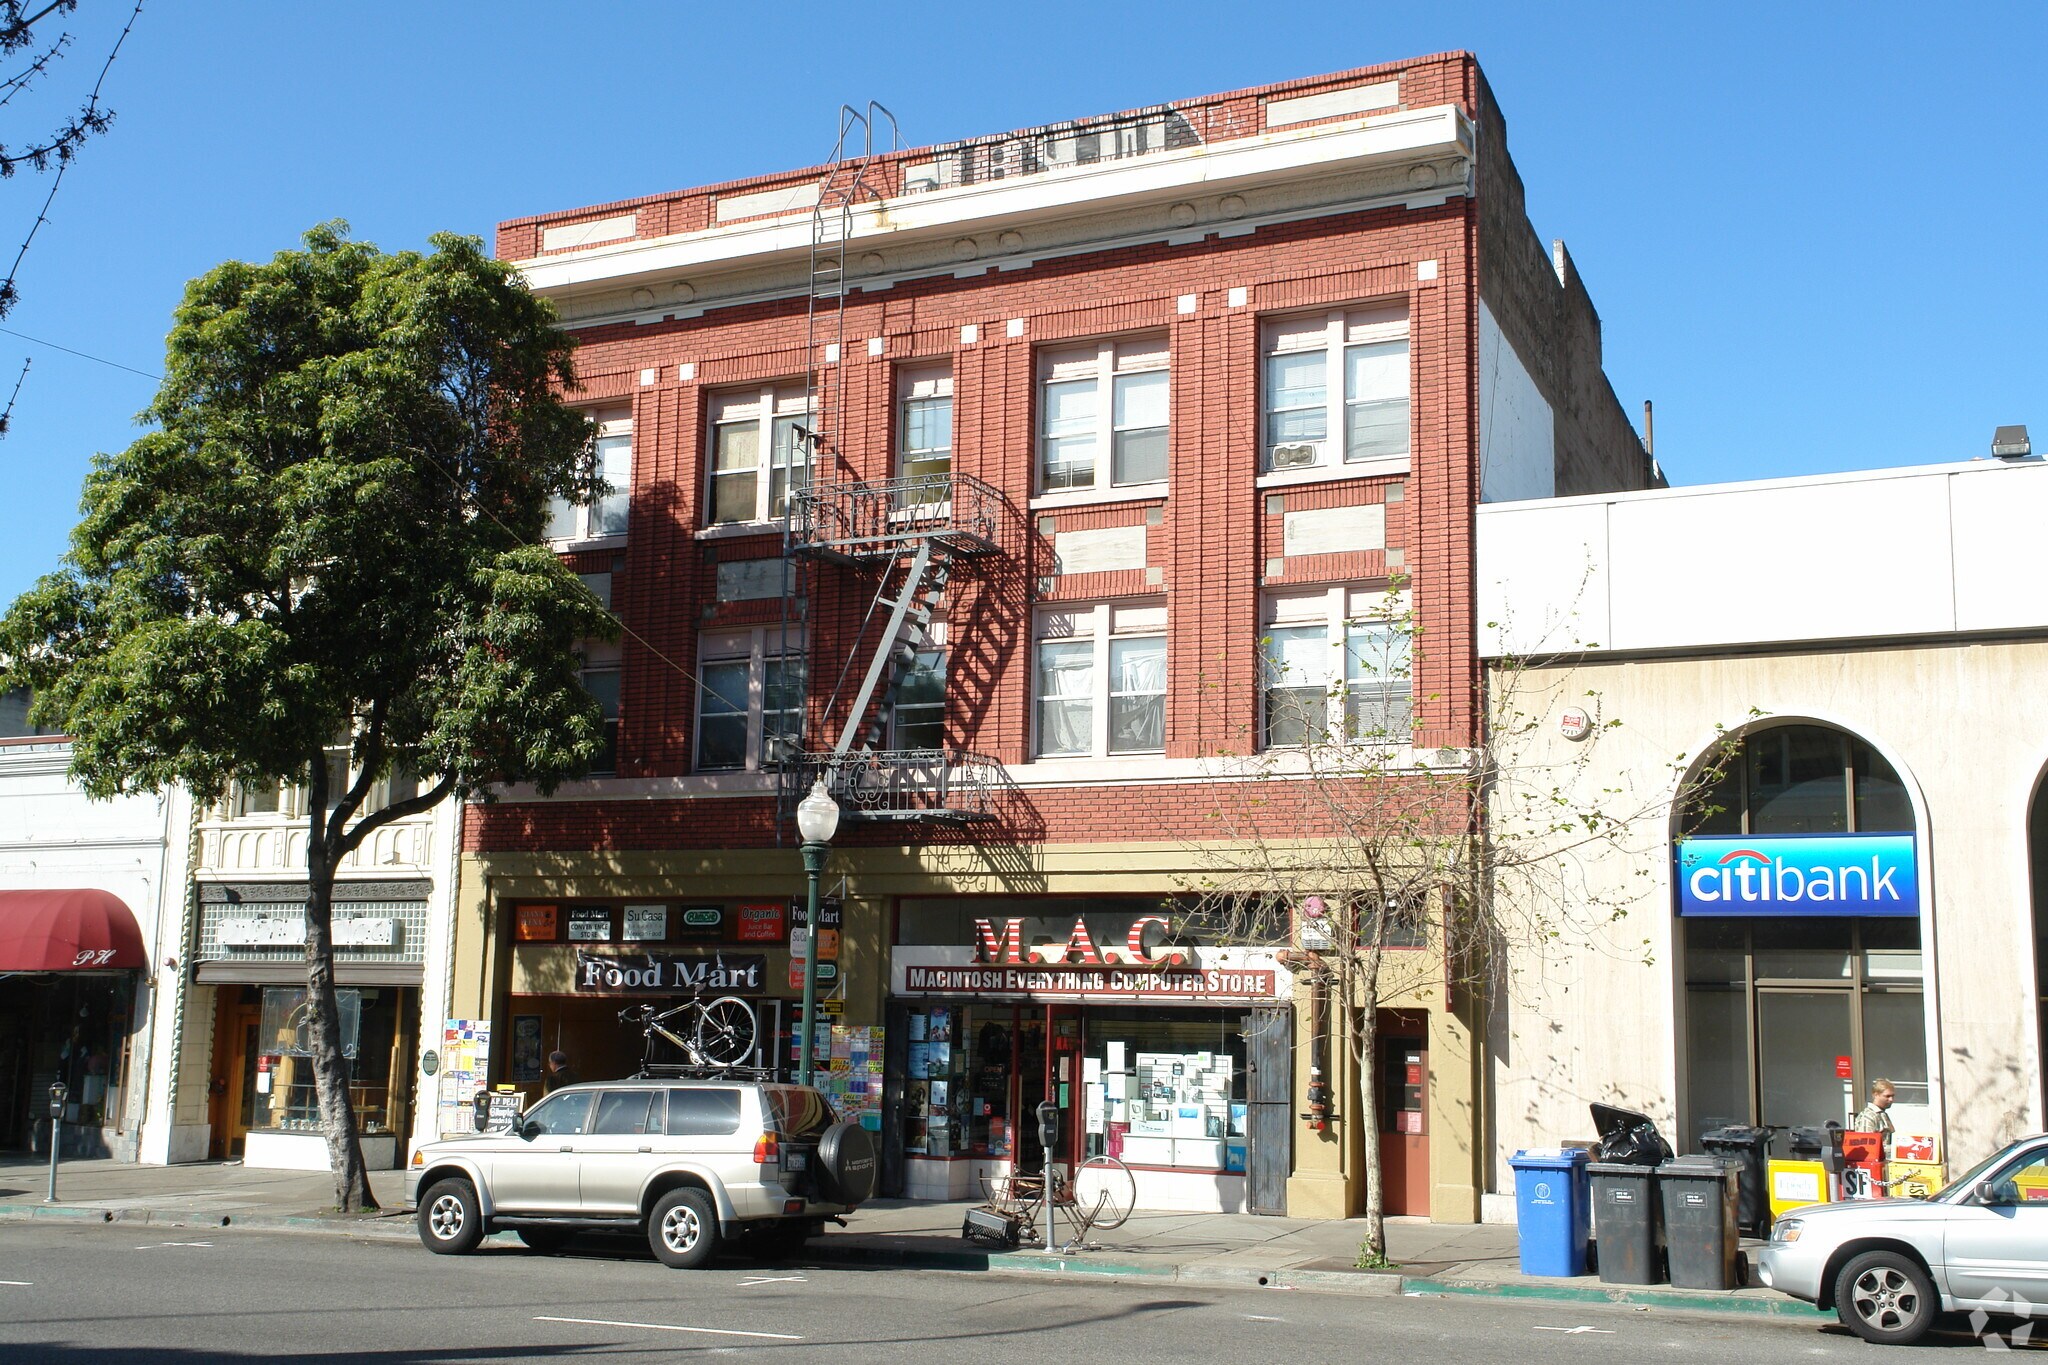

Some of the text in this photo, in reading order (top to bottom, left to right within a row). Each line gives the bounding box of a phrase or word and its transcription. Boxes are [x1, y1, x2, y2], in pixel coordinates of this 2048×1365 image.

[1689, 855, 1901, 902] citibank
[572, 910, 608, 918] Food Mart
[628, 910, 663, 922] Su Casa
[742, 907, 780, 922] Organic
[792, 906, 808, 920] Foo
[757, 930, 776, 938] Coffee
[970, 915, 1186, 965] M.A.C.
[582, 961, 759, 988] Food Mart
[909, 968, 1267, 993] MACINTOSH EVERYTHING COMPUTER STORE
[1846, 1170, 1868, 1196] SF
